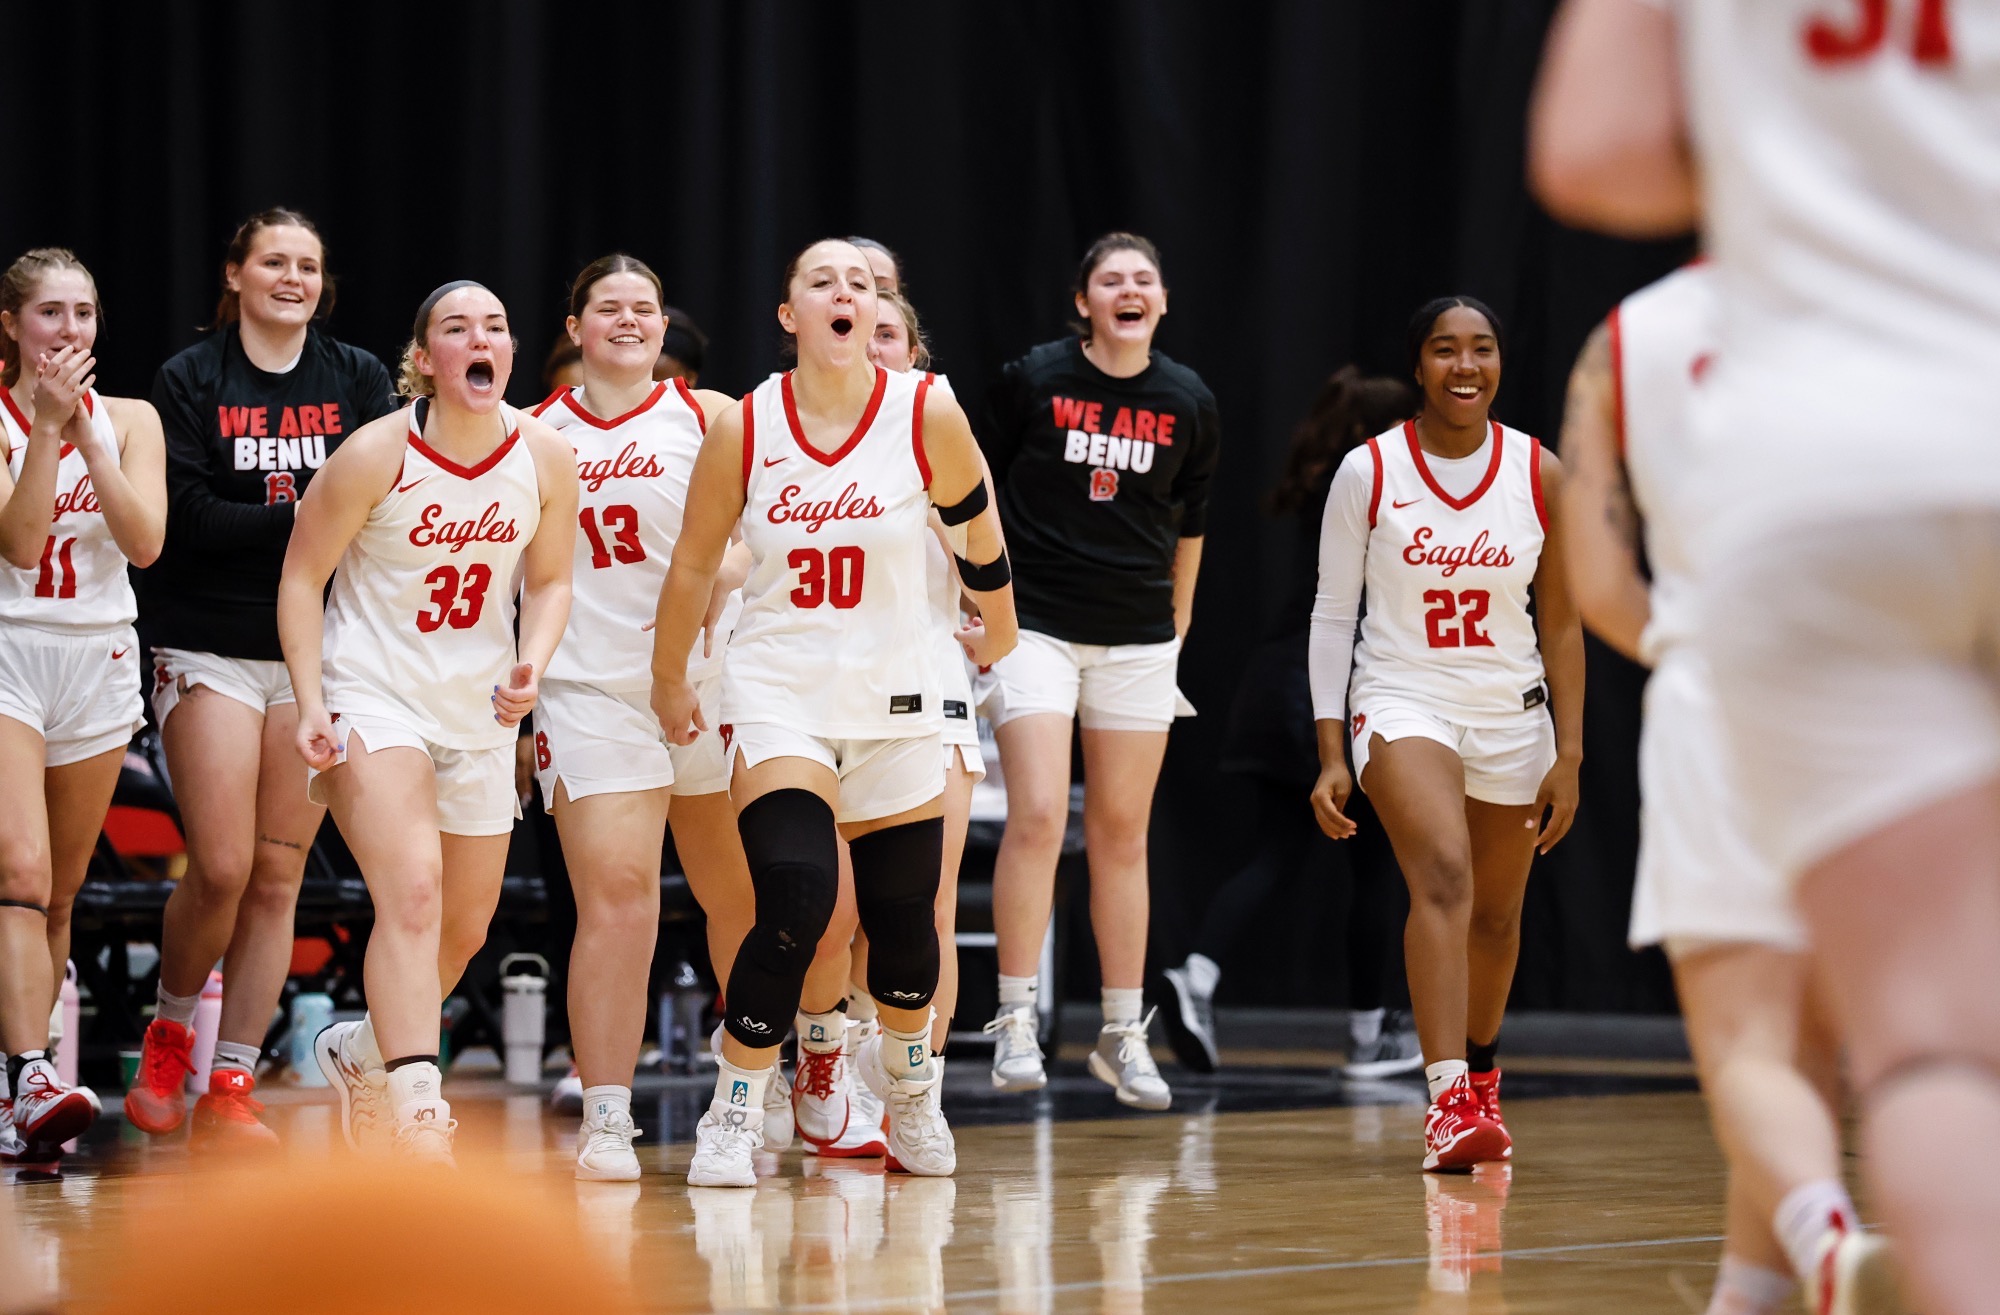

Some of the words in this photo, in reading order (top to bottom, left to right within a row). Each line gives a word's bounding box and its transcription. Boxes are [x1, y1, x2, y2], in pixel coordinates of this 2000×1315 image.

[218, 405, 269, 438] WE
[279, 402, 342, 438] ARE
[1052, 396, 1103, 433] WE
[1110, 407, 1176, 446] ARE
[234, 435, 327, 471] BENU
[573, 441, 664, 492] agles
[1064, 429, 1155, 474] BENU
[52, 474, 101, 522] gle
[264, 471, 298, 506] B
[768, 482, 885, 533] Eagles
[1089, 467, 1119, 501] B
[409, 501, 519, 553] Eagles
[578, 504, 647, 569] 13
[1402, 527, 1514, 577] Eagles
[35, 535, 77, 598] 11
[787, 546, 865, 609] 30
[415, 563, 492, 633] 33
[1423, 589, 1495, 648] 22
